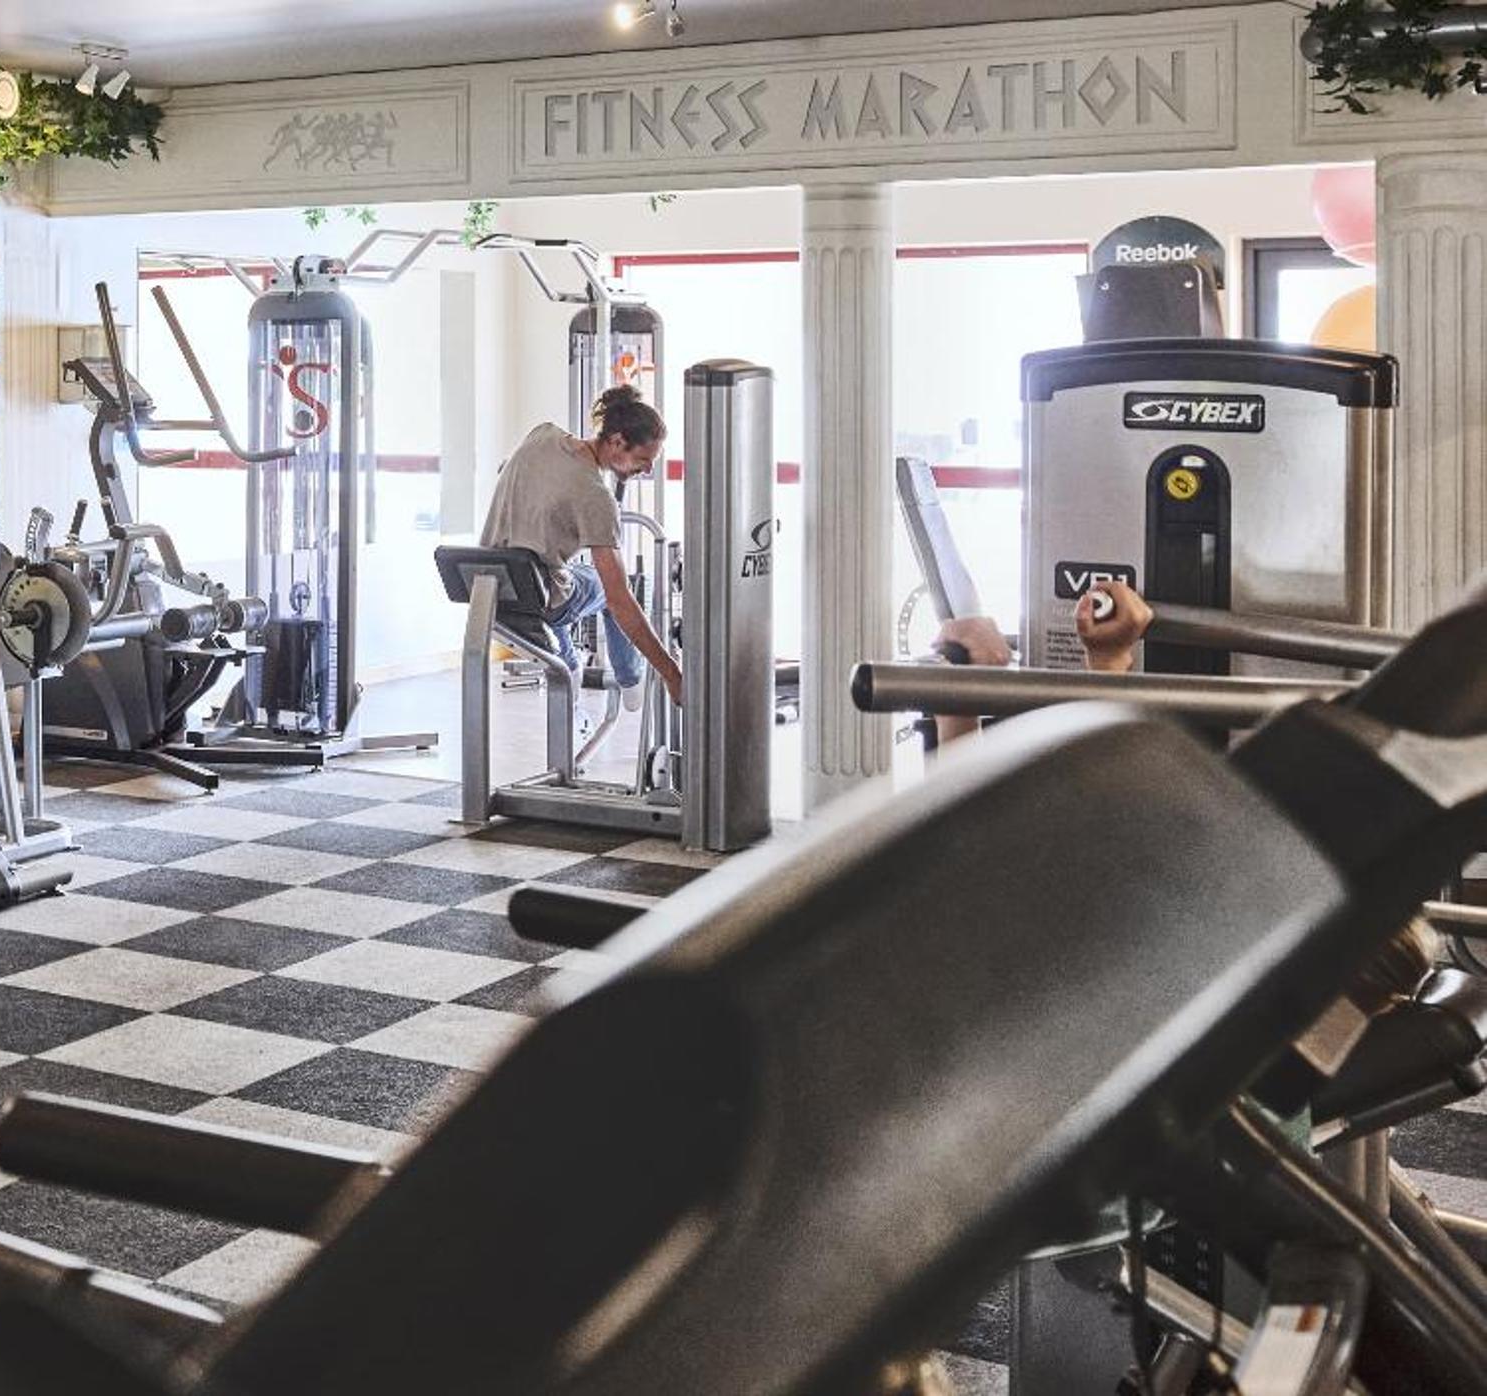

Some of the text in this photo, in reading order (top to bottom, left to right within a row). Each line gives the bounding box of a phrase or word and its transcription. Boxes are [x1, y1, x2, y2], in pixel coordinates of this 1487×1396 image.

[544, 50, 1187, 157] FITNESS MARATHON
[1116, 243, 1200, 263] Reebok
[1169, 401, 1257, 424] CYBEX
